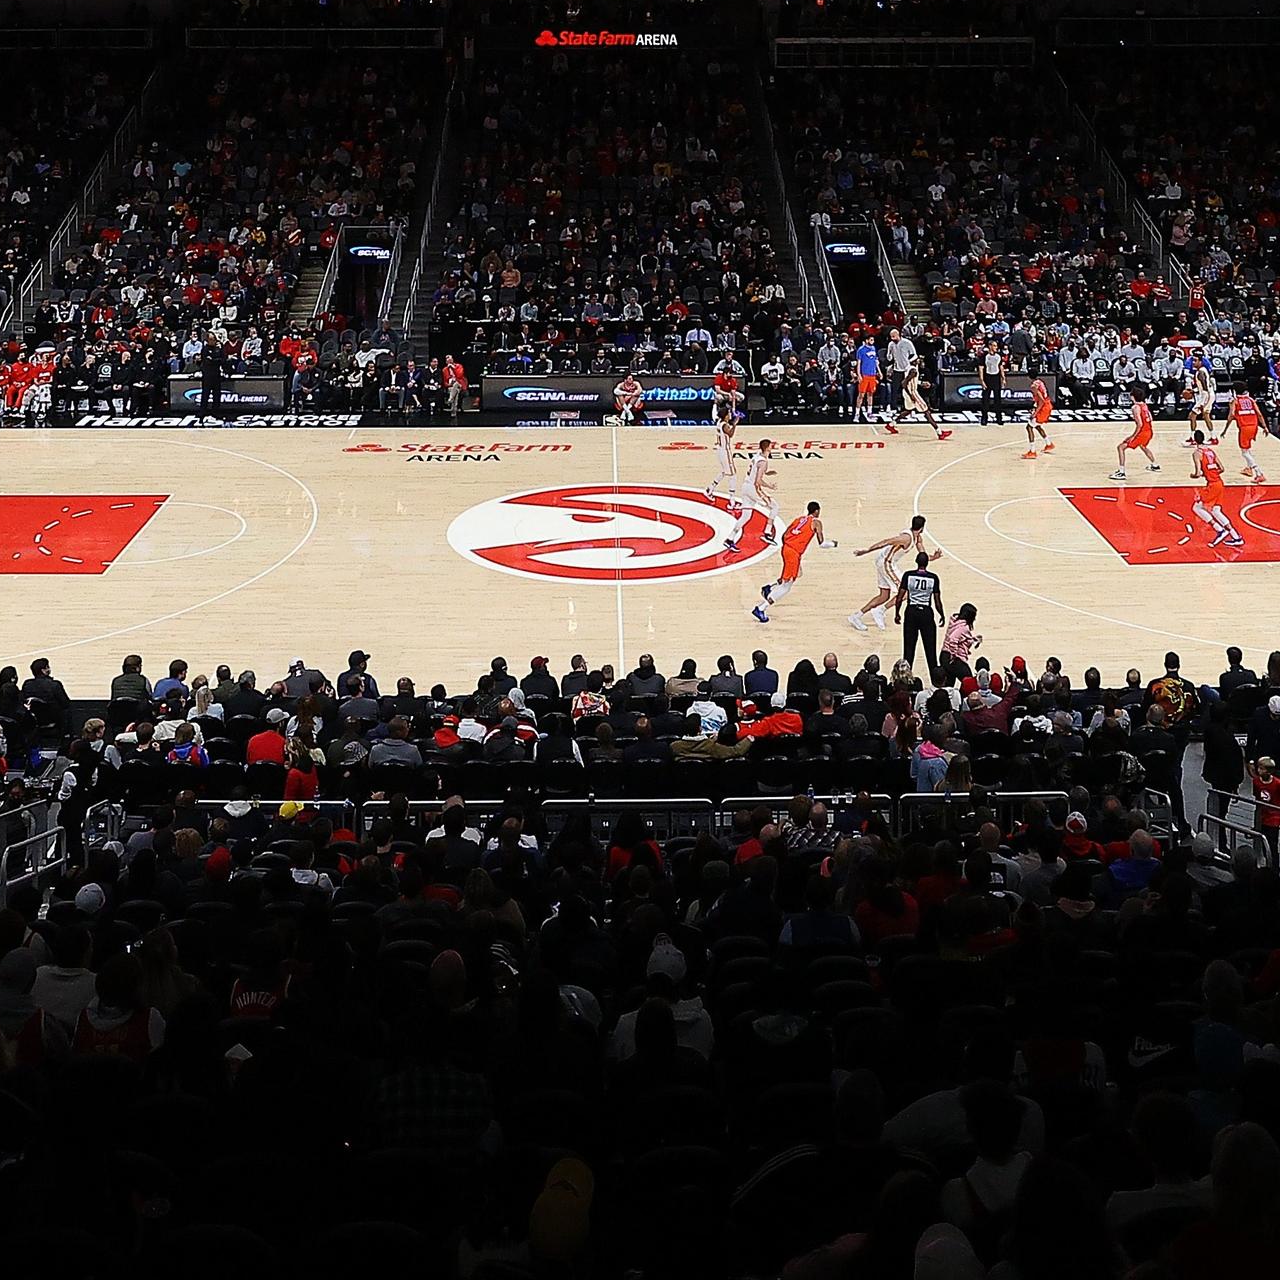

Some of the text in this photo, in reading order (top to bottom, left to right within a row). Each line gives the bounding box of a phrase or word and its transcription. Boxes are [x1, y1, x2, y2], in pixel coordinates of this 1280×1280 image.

[635, 34, 678, 46] ARENA
[516, 392, 599, 402] SCANA ENERGY
[803, 440, 885, 450] Farm
[405, 454, 502, 462] ARENA
[914, 578, 927, 591] 70
